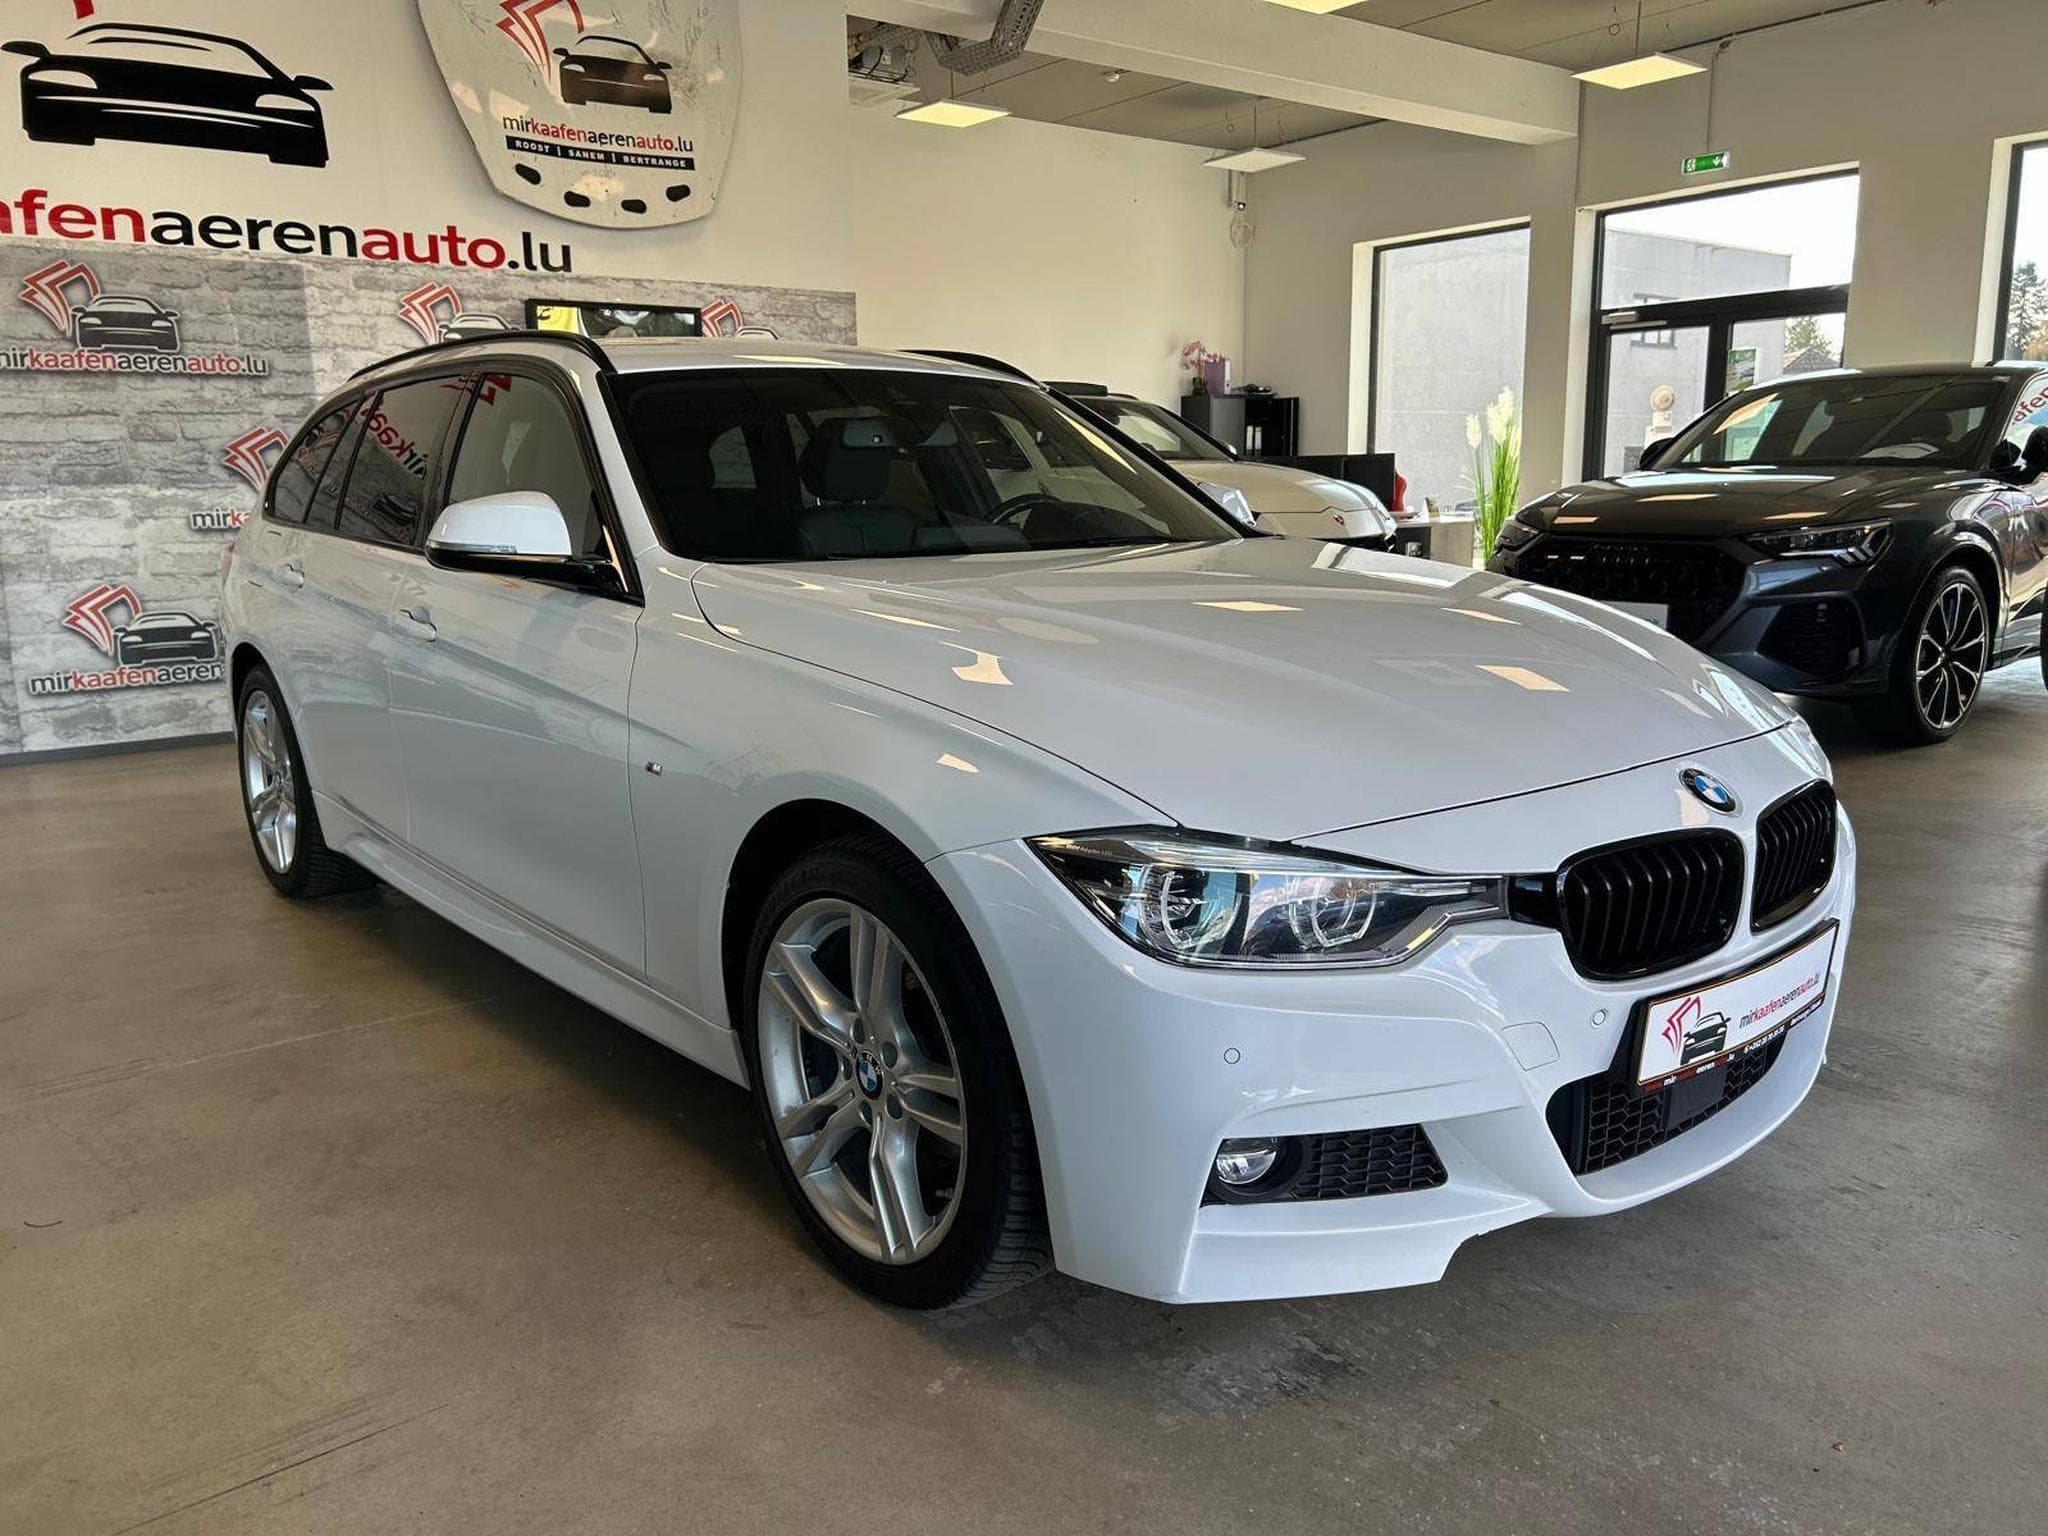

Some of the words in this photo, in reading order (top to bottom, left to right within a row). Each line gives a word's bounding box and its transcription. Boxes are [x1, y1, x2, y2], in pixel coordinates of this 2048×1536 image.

[502, 115, 694, 152] mirkaafenaerenauto.lu
[515, 139, 550, 154] ROOST
[568, 148, 605, 161] SANEM
[623, 156, 687, 169] BERTRANGE
[0, 188, 572, 273] fenaerenauto.lu
[192, 508, 252, 528] mirk
